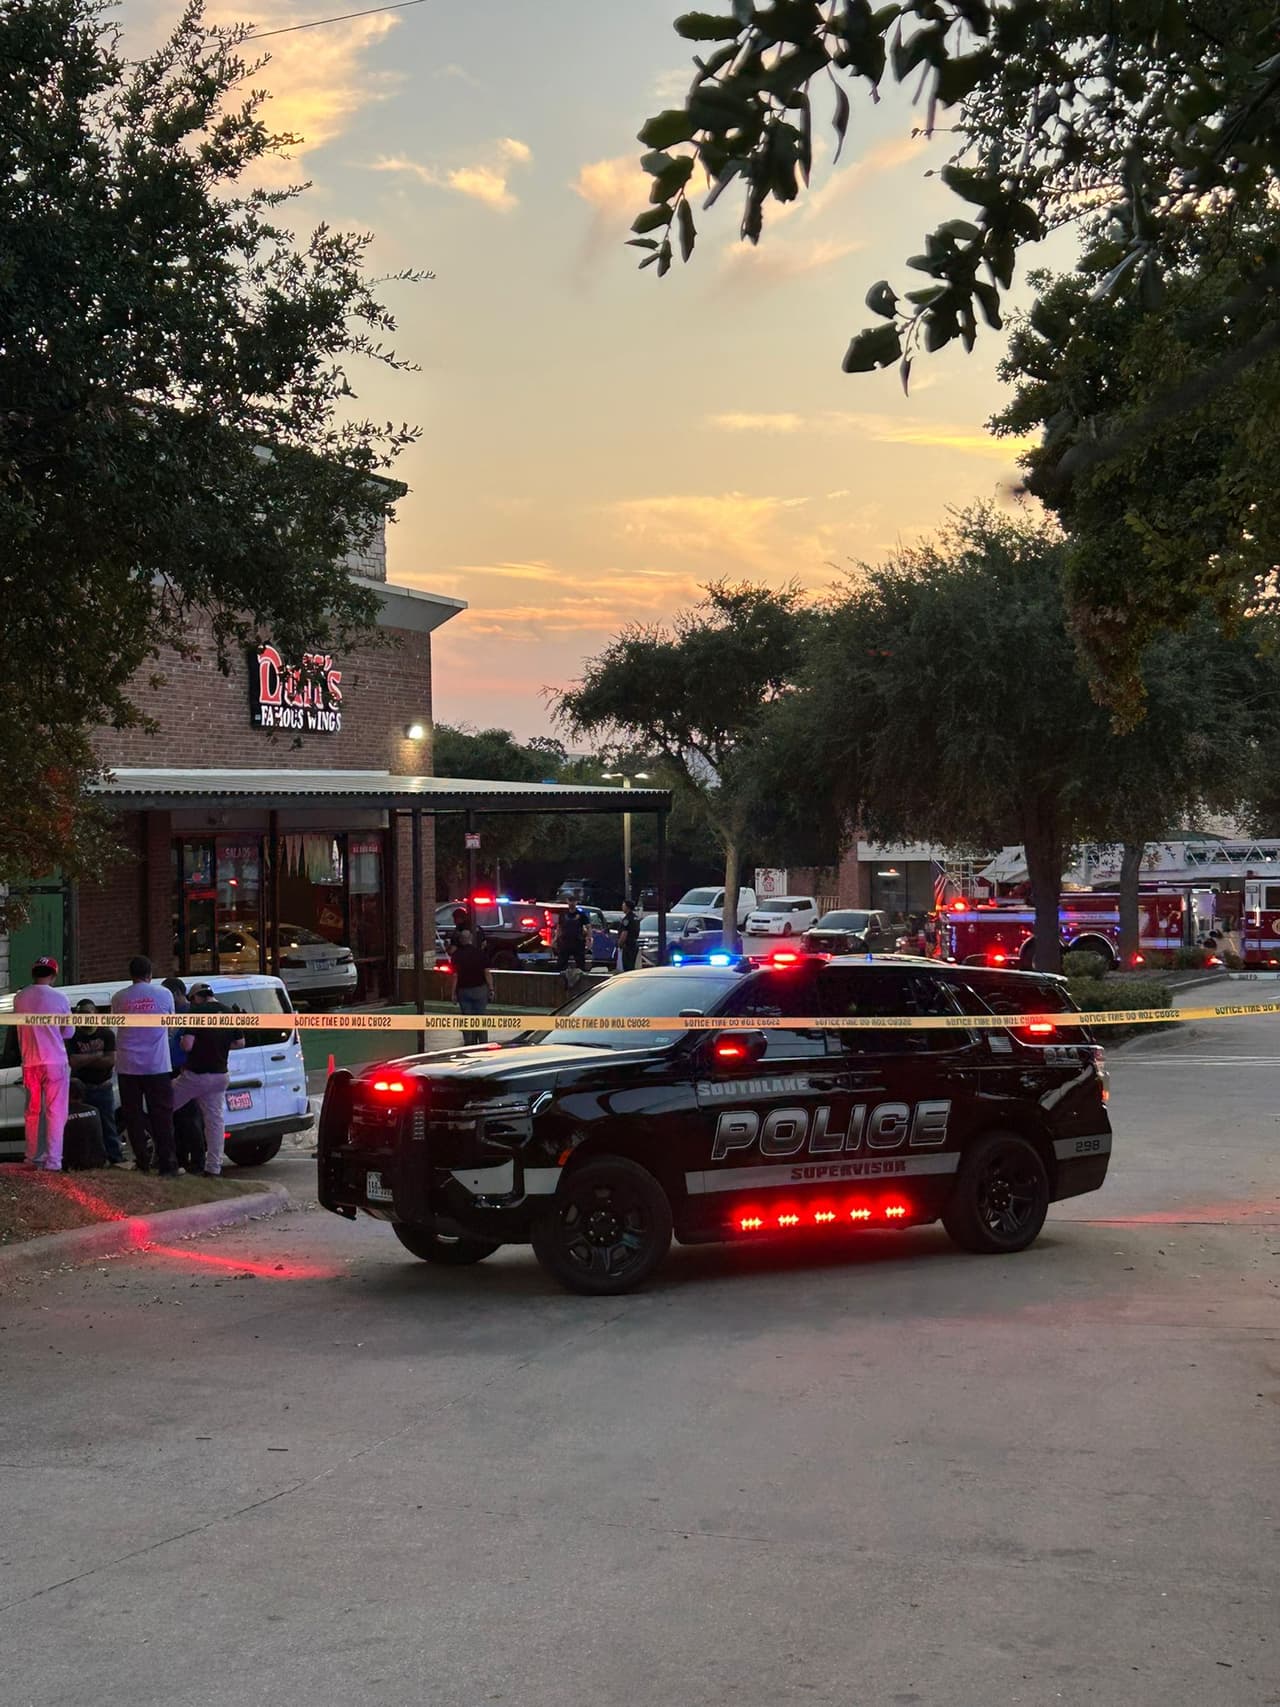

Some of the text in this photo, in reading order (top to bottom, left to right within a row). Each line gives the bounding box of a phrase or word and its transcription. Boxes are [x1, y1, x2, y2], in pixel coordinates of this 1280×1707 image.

[307, 710, 342, 732] WINGS
[698, 1078, 809, 1097] SOUTHLAKE
[711, 1099, 952, 1160] POLICE
[1075, 1140, 1100, 1152] 298
[791, 1160, 906, 1180] SUPERVISOR
